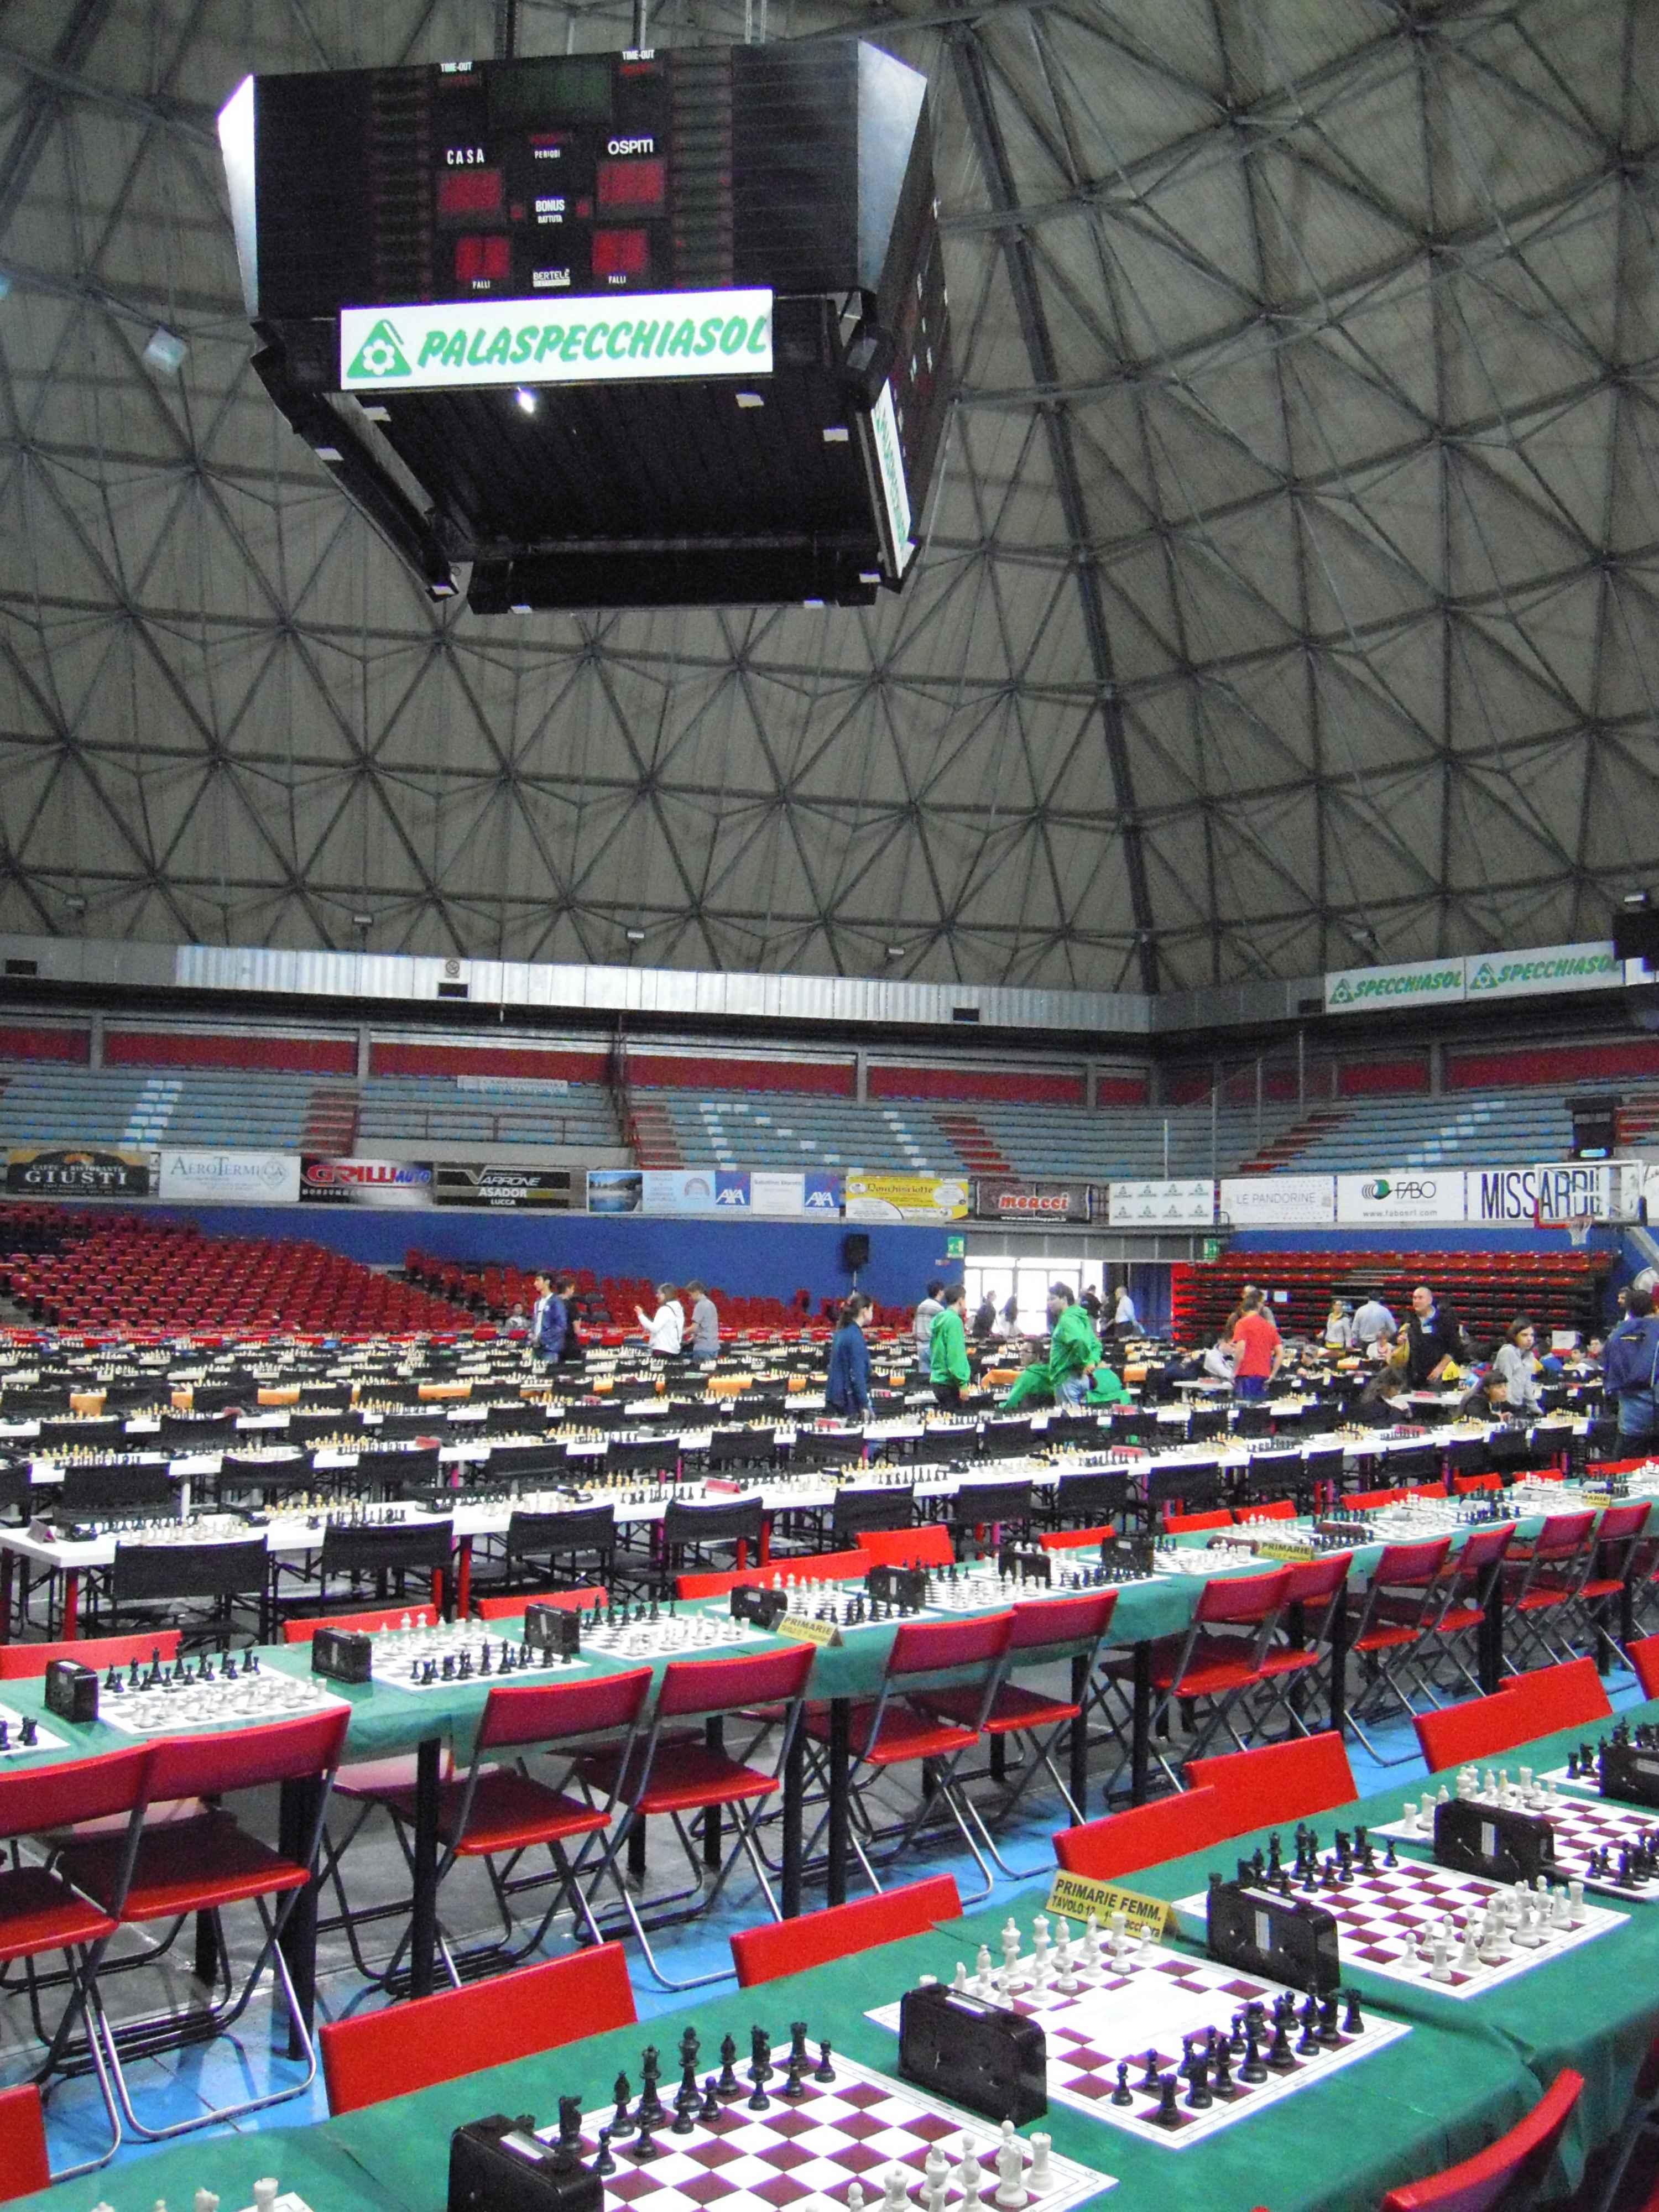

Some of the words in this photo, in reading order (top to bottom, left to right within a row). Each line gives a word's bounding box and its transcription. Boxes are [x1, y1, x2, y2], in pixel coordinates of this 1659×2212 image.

[622, 50, 655, 60] TIME-OUT
[441, 62, 472, 72] TIME-OUT
[608, 139, 654, 155] OSPITI
[447, 149, 485, 165] CASA
[536, 200, 565, 212] BONUS
[472, 280, 491, 289] FALLI
[608, 275, 627, 284] FALLI
[418, 314, 767, 368] PALASPECCHIASOL
[1498, 953, 1621, 983] SPECCHIASOL
[1353, 970, 1463, 999] SPECCHIASOL
[25, 1171, 128, 1185] GIUSTI
[478, 1187, 528, 1198] ASADOR
[716, 1188, 745, 1204] AXA
[1236, 1194, 1249, 1204] LE
[1253, 1192, 1316, 1204] PANDORINE
[1395, 1181, 1437, 1199] FABO
[805, 1191, 834, 1207] AXA
[999, 1192, 1070, 1211] meacci
[1261, 1542, 1311, 1555] PRIMARIE
[783, 1616, 834, 1635] PRIMARIE
[1052, 1895, 1084, 1914] TAVOLO
[1055, 1879, 1118, 1908] PRIMARIE
[1120, 1897, 1162, 1922] FEMM.
